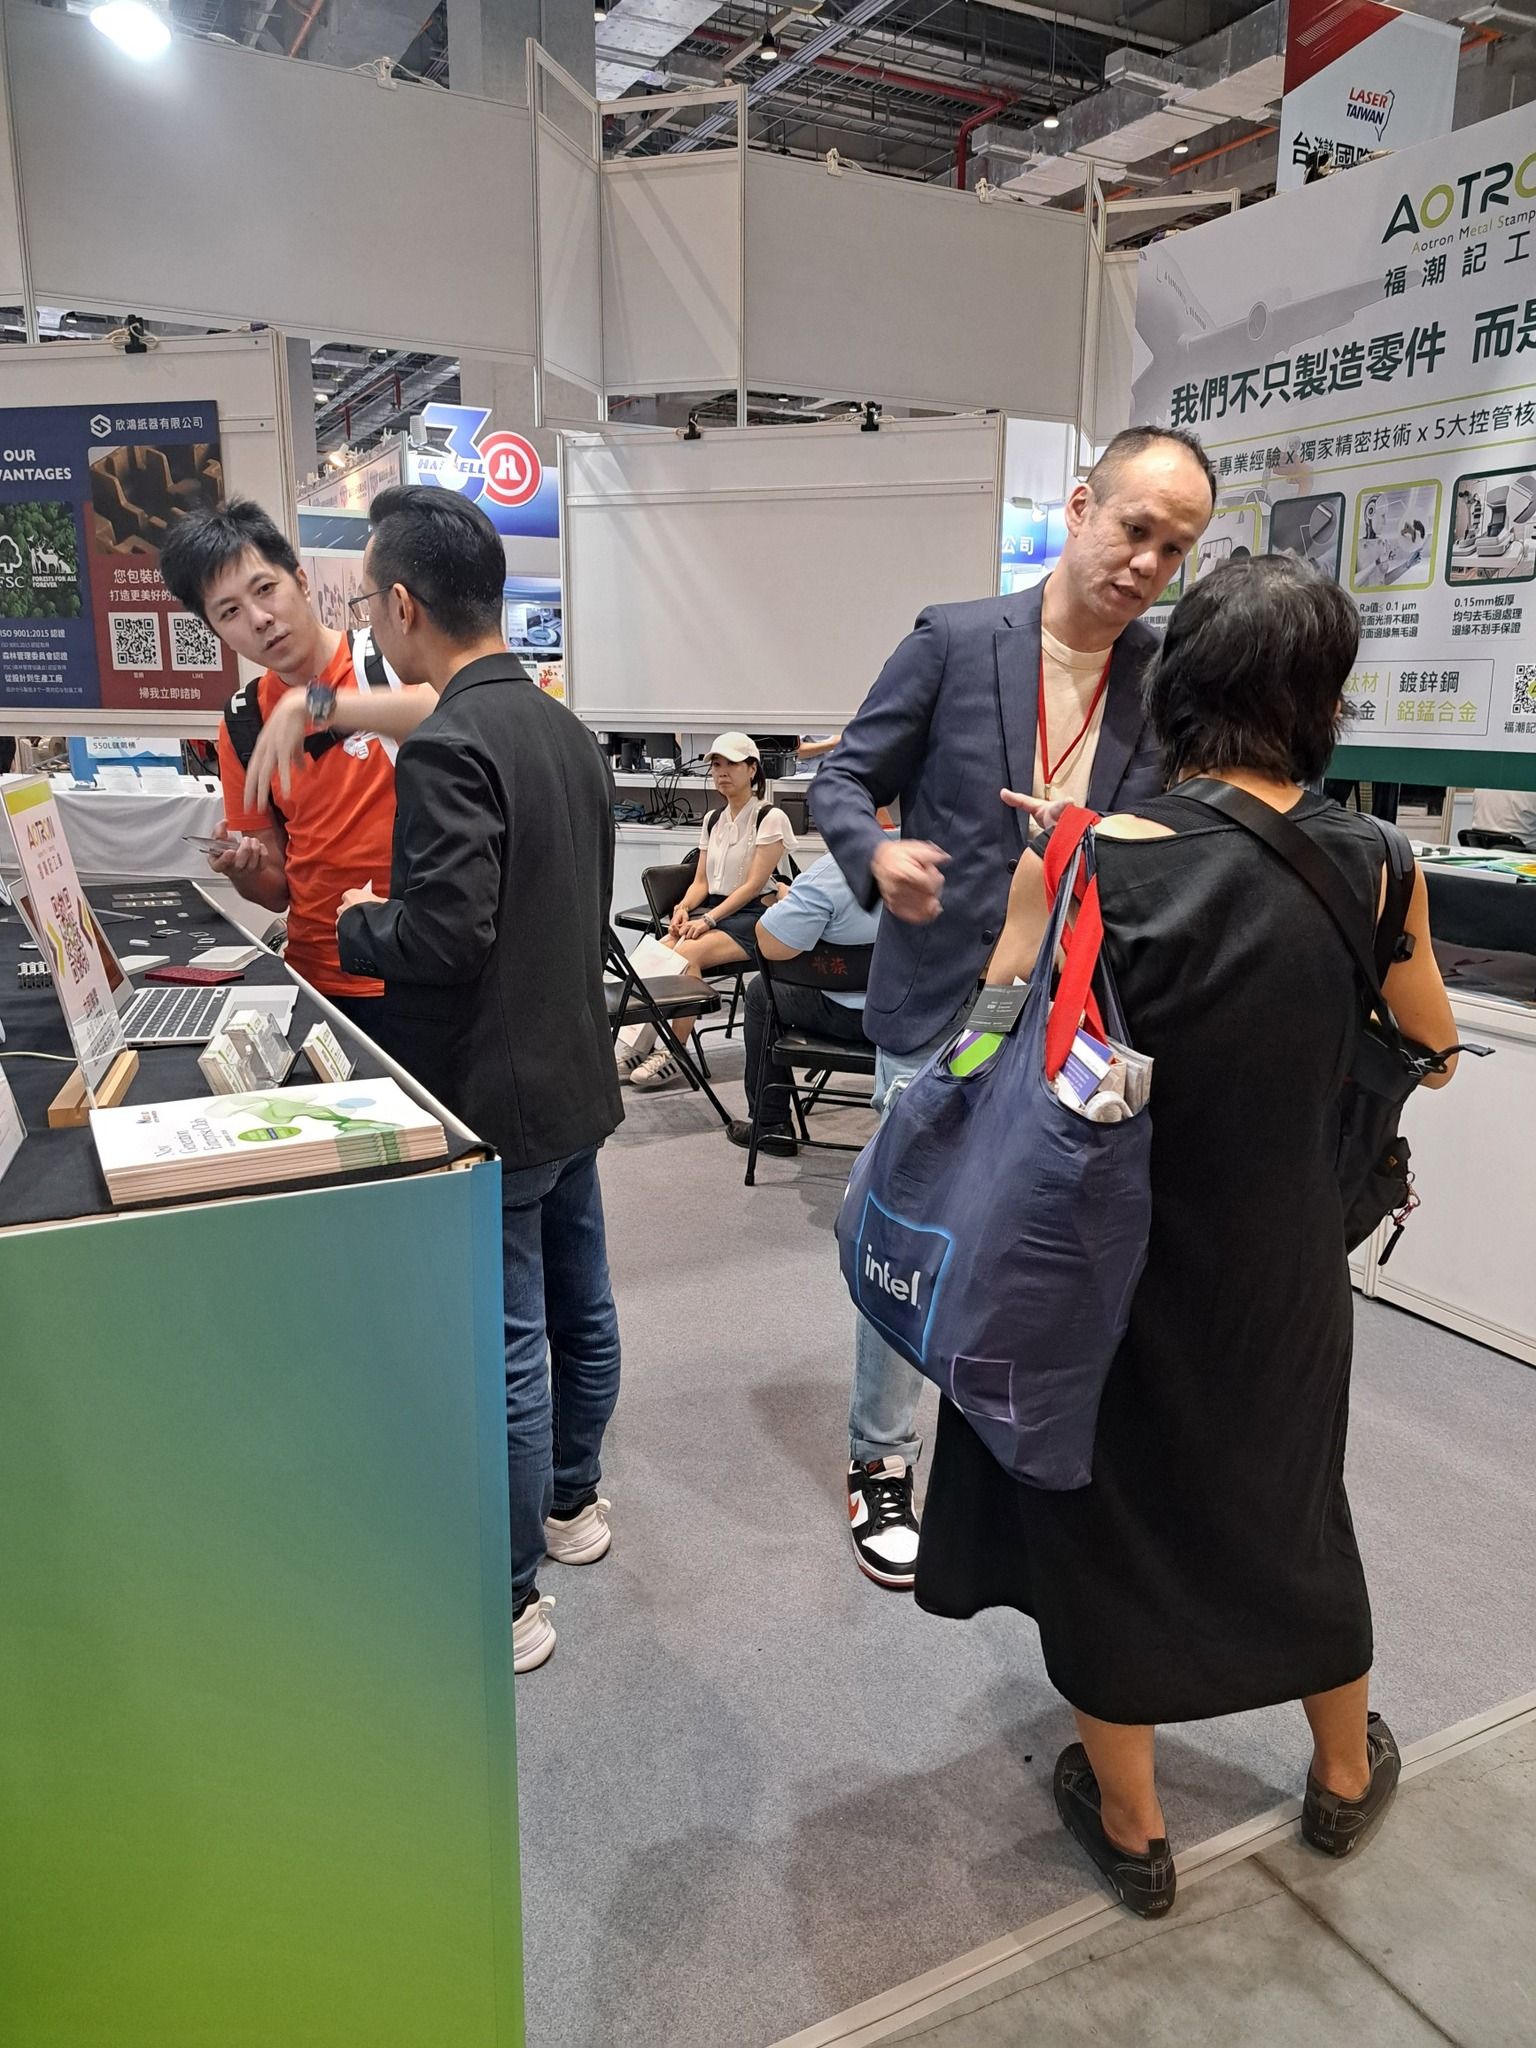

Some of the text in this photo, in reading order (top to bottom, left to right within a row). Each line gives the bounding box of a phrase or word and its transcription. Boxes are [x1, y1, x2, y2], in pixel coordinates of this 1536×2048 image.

[1349, 87, 1389, 109] LASER
[1346, 103, 1385, 125] TAIWAN
[1411, 234, 1454, 255] Aotron
[1459, 219, 1493, 240] Metal
[1384, 230, 1531, 298] 福潮記工
[1171, 322, 1446, 428] 我們不只製造零件
[115, 416, 204, 431] 欣鴻紙器有限公司
[1300, 422, 1412, 463] 獨家精密技術
[3, 449, 36, 462] OUR
[110, 589, 177, 602] 打造更美好的
[1385, 601, 1399, 611] 0.1
[1454, 594, 1515, 608] 0.15mm板厚
[1453, 608, 1523, 623] 均勻去毛邊處理
[1399, 671, 1460, 694] 鍍鋅鋼
[1397, 700, 1478, 723] 鋁錳合金
[865, 1243, 921, 1307] intel
